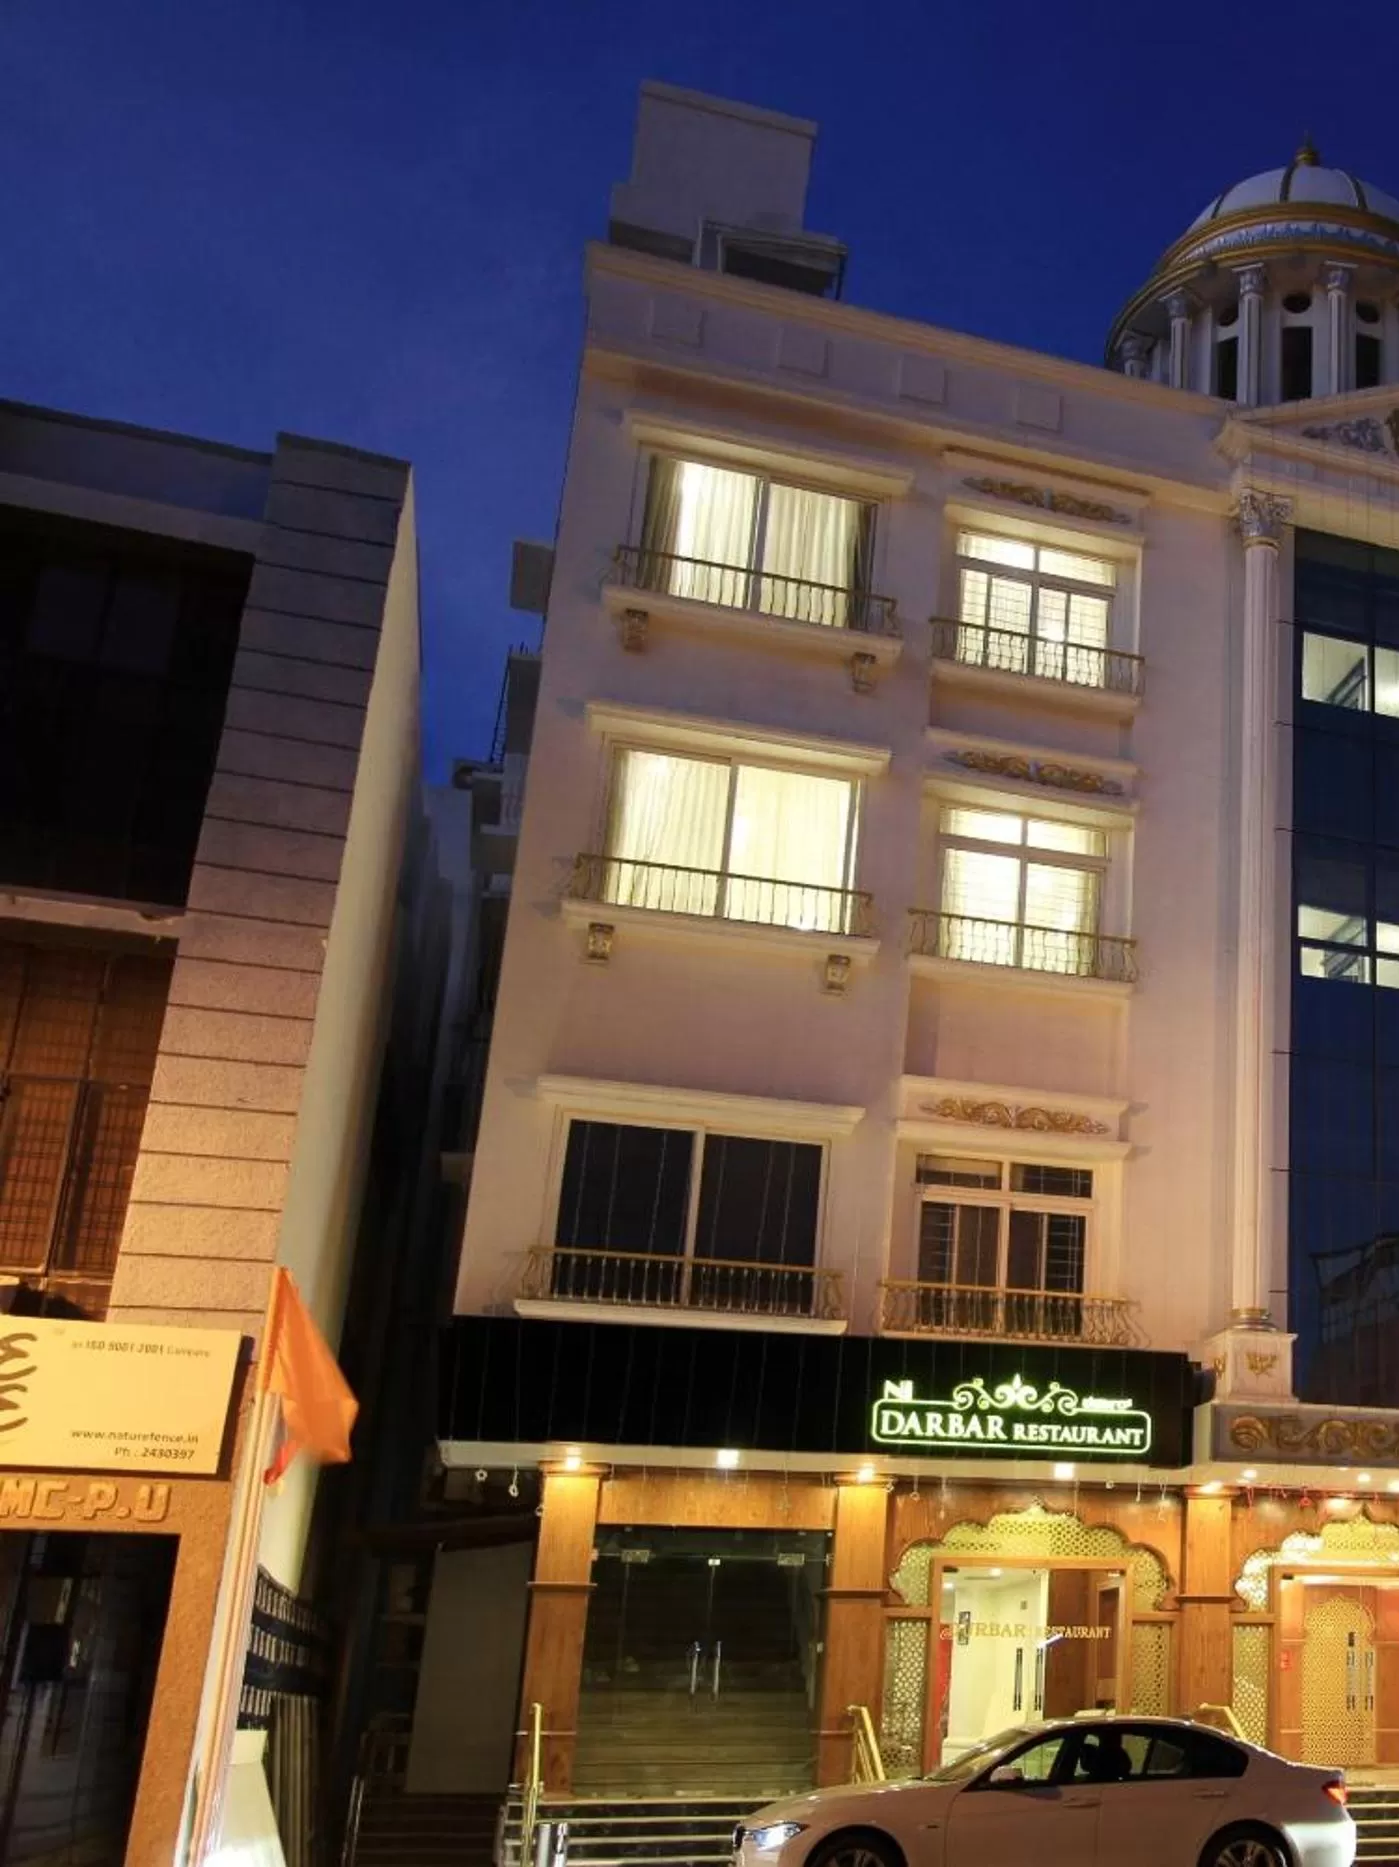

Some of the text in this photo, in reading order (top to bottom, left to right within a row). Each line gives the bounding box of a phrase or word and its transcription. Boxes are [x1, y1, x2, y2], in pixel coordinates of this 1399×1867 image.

[86, 1340, 105, 1351] ISO
[881, 1410, 1144, 1445] DARBAR RESTAURANT
[71, 1429, 199, 1445] www.naturefence.in
